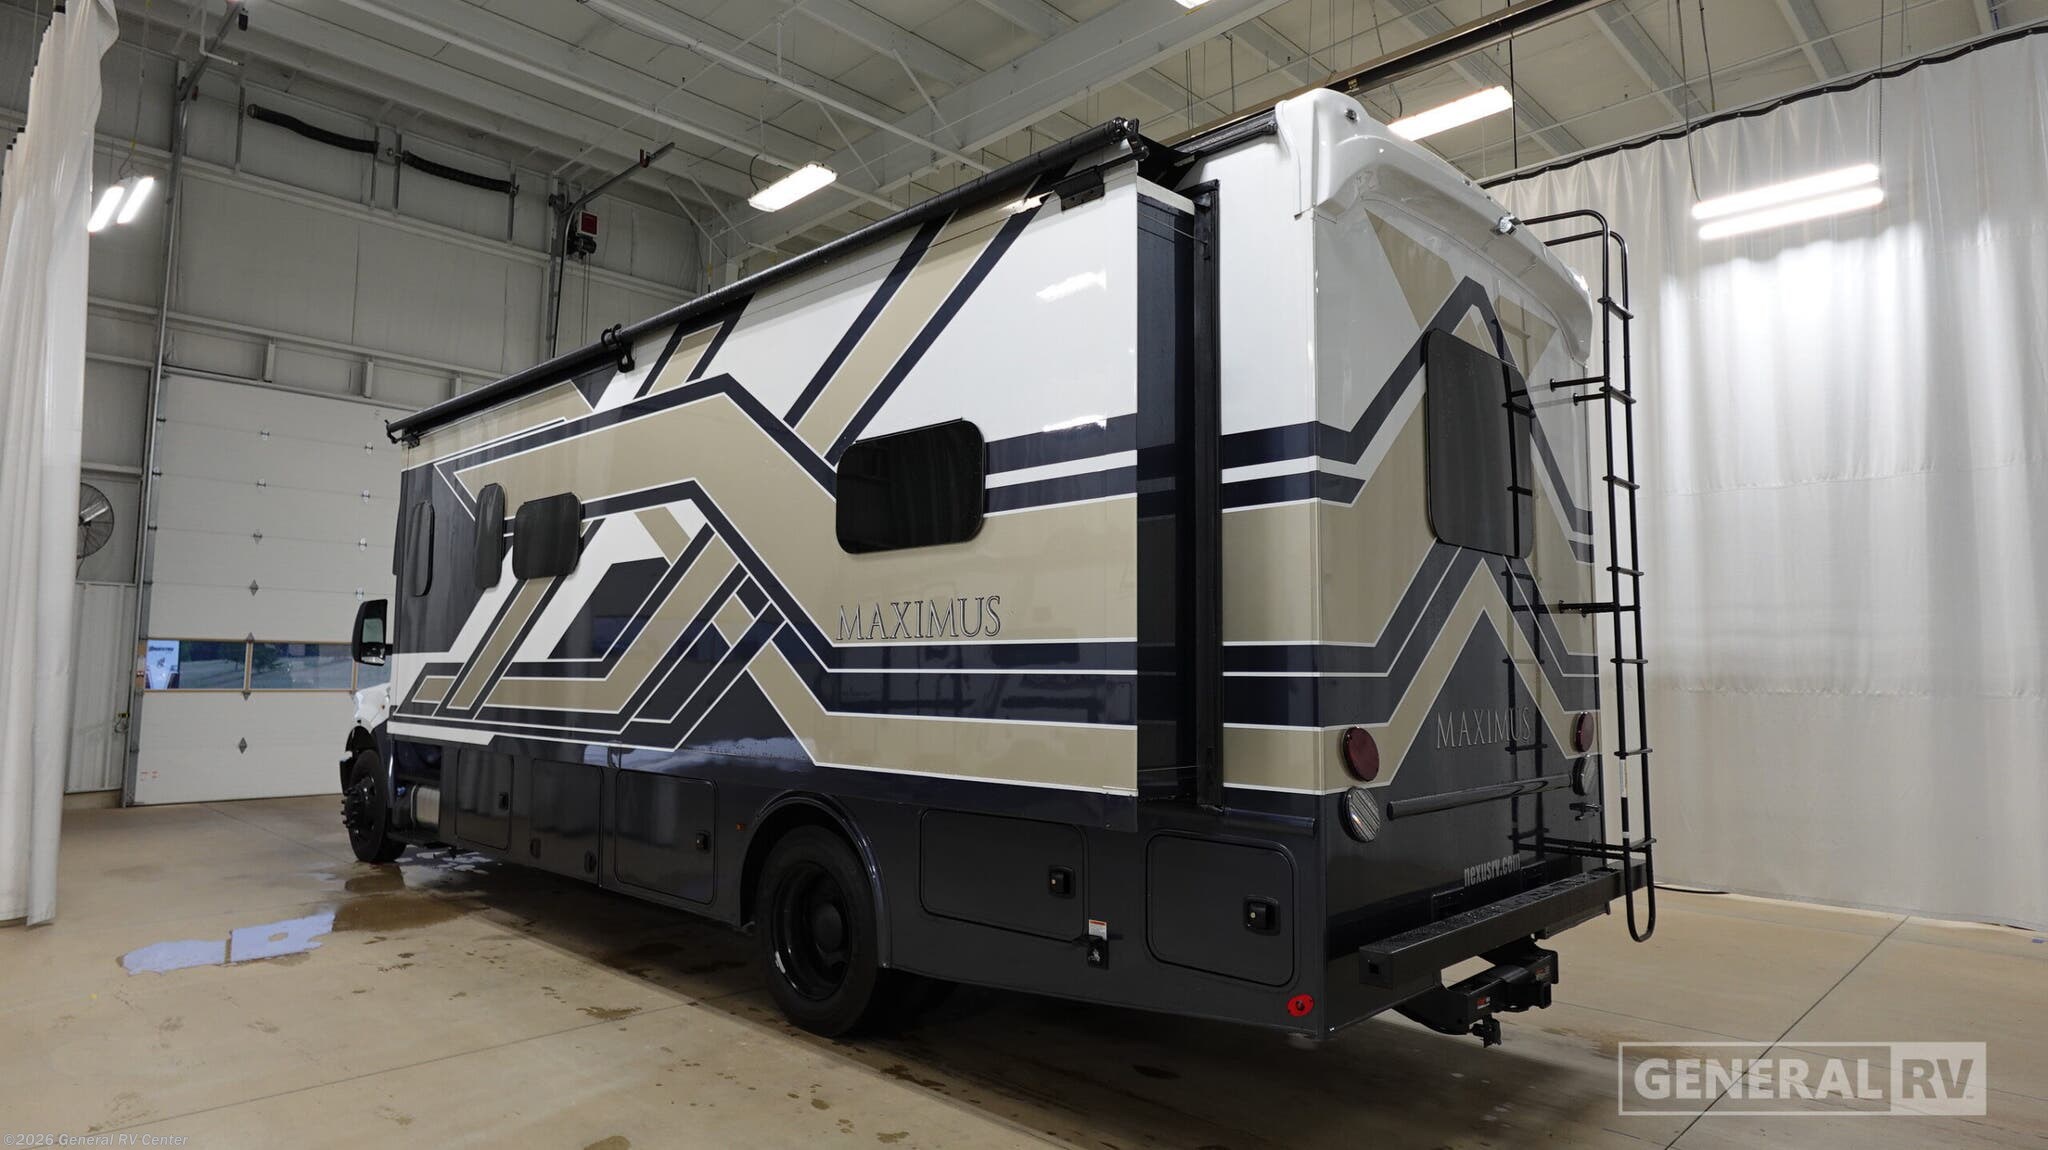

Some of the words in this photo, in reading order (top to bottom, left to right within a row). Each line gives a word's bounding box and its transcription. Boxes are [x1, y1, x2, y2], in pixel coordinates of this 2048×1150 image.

[836, 595, 1001, 640] MAXIMUS
[1436, 706, 1531, 749] MAXIMUS
[1464, 853, 1521, 887] nexusrv.com
